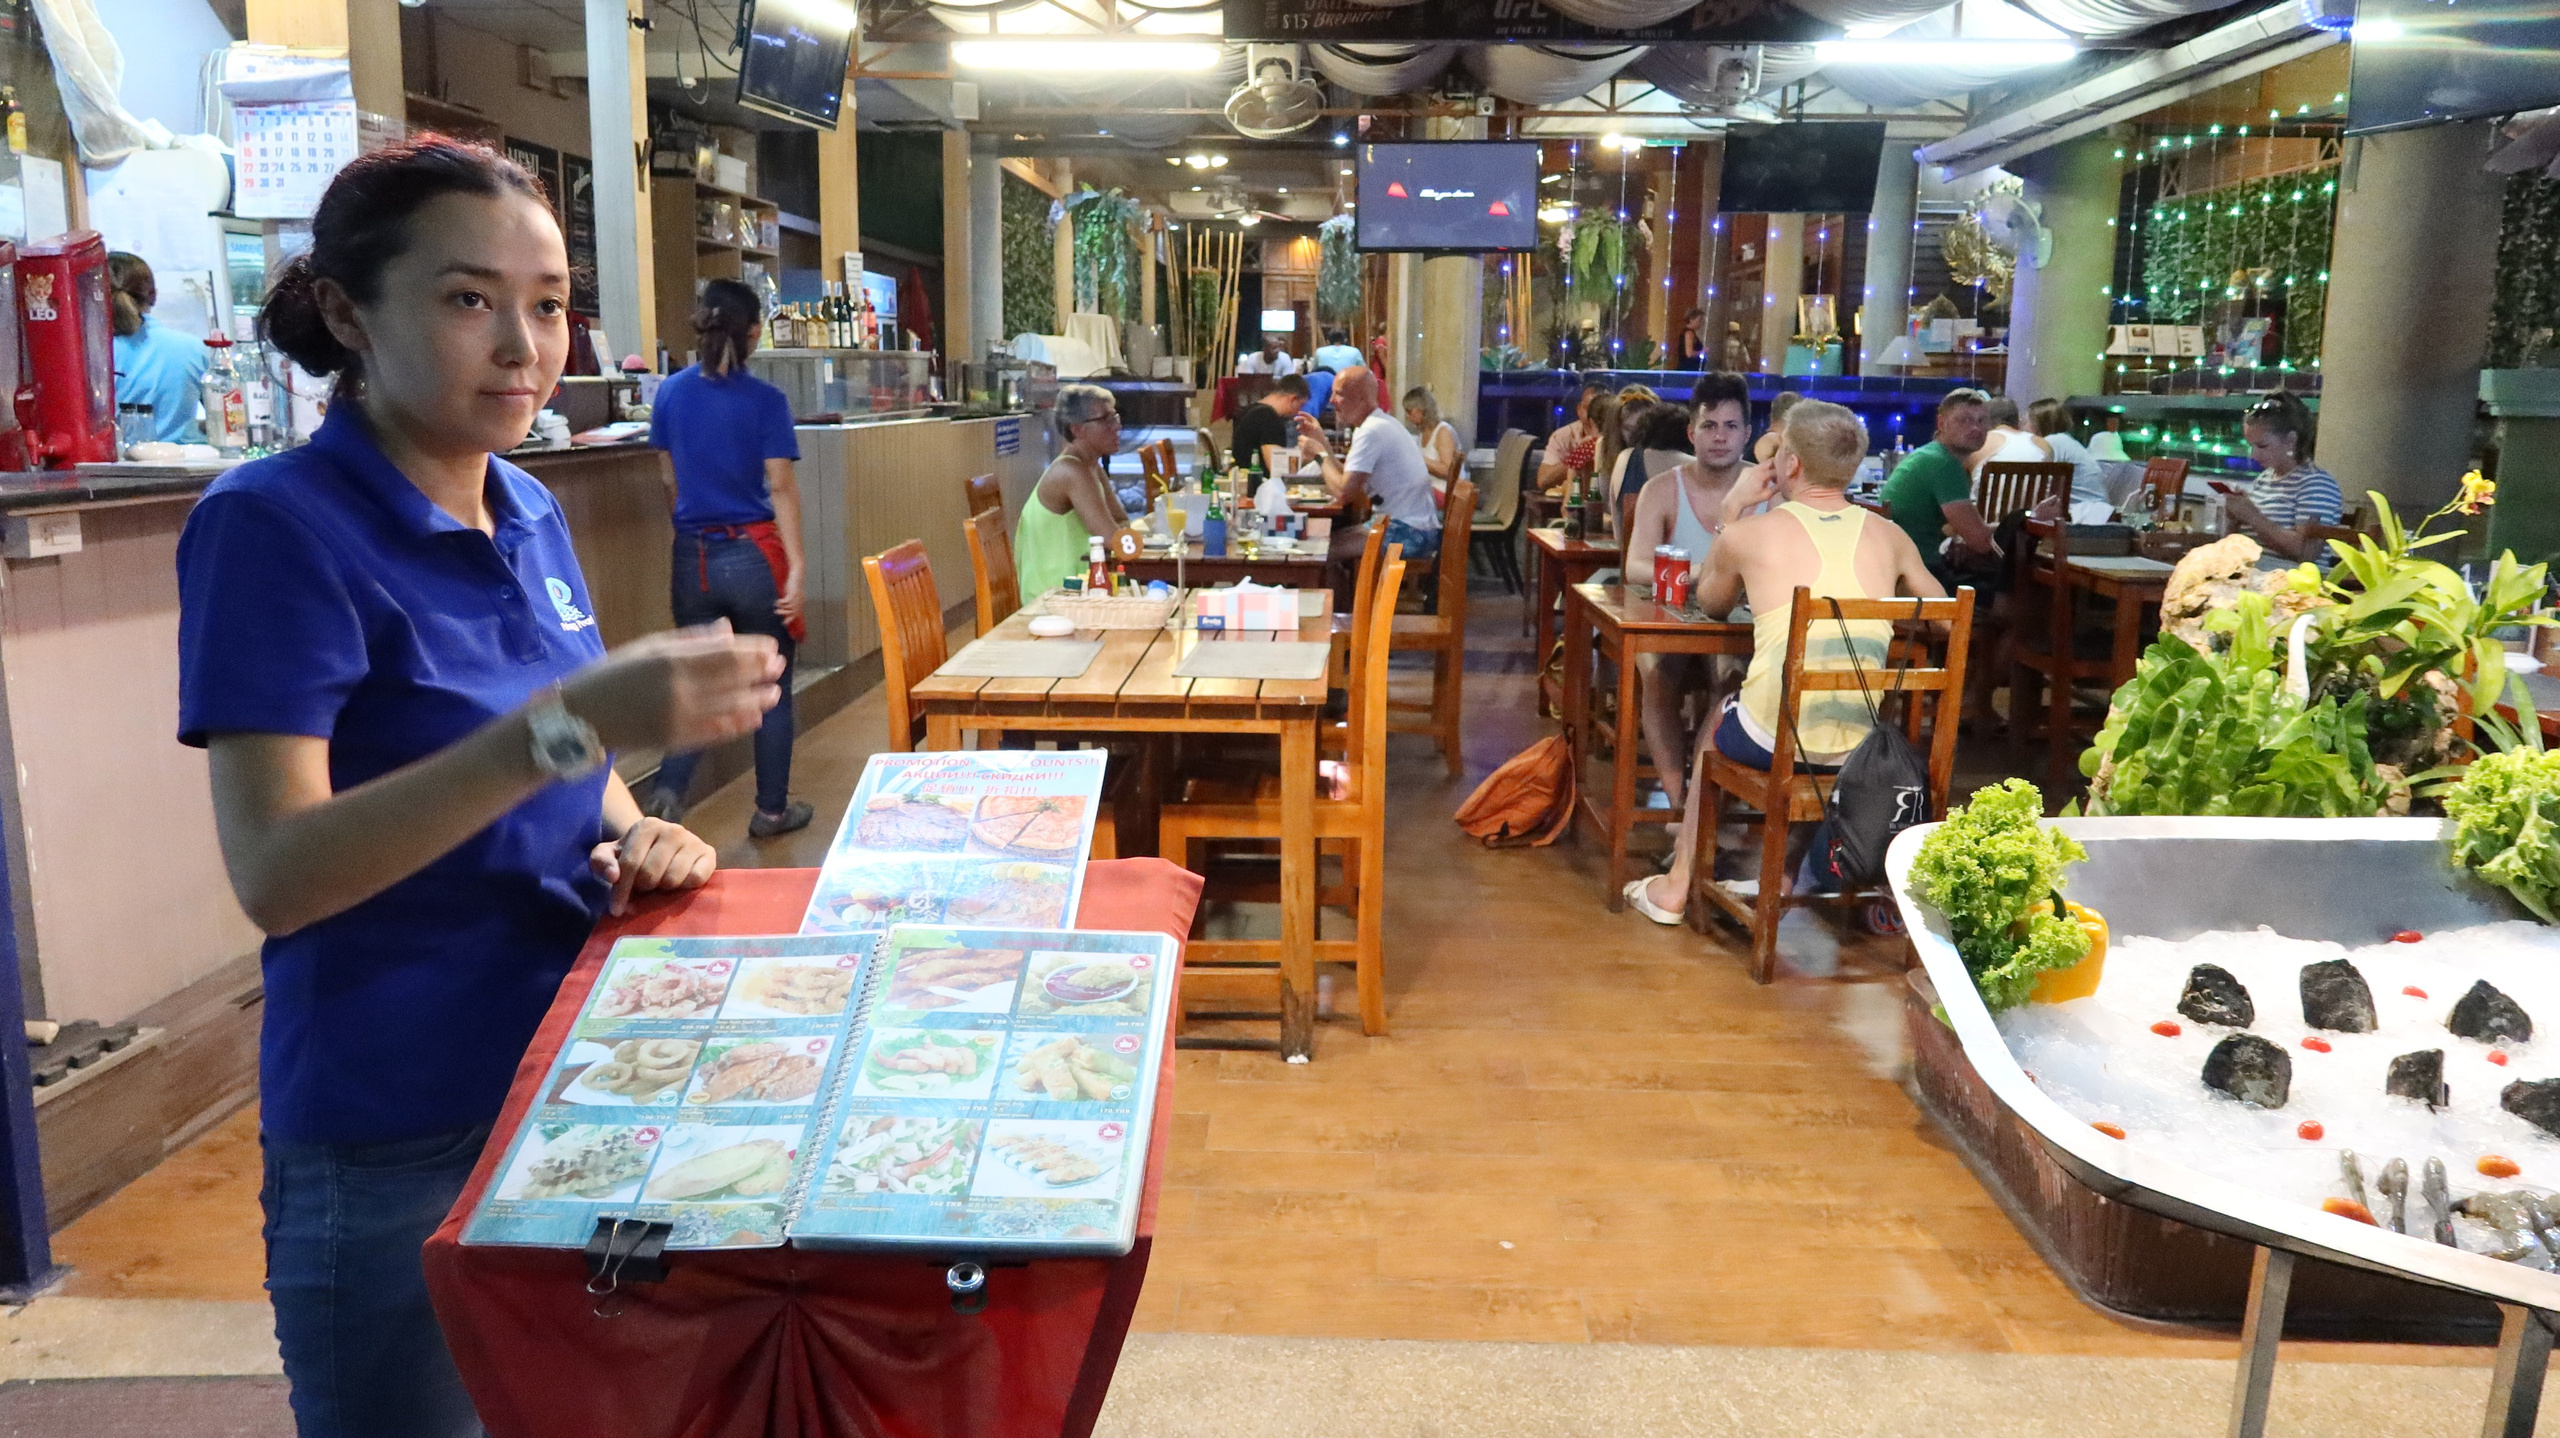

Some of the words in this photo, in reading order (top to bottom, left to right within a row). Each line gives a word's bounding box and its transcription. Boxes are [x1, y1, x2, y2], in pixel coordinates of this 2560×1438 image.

[1494, 0, 1549, 19] UFC
[244, 116, 248, 126] 1
[260, 116, 266, 126] 2
[276, 116, 282, 126] 3
[291, 116, 297, 126] 4
[308, 116, 314, 126] 5
[324, 116, 330, 126] 6
[244, 132, 250, 142] 8
[260, 132, 266, 142] 9
[274, 132, 283, 142] 10
[292, 132, 298, 142] 11
[306, 132, 316, 142] 12
[324, 132, 333, 142] 13
[244, 148, 252, 157] 15
[260, 148, 268, 157] 16
[274, 148, 283, 157] 17
[291, 148, 300, 157] 18
[308, 148, 317, 157] 19
[324, 148, 334, 157] 20
[243, 163, 254, 172] 22
[259, 163, 269, 172] 23
[274, 163, 285, 172] 24
[290, 163, 302, 172] 25
[308, 163, 318, 172] 26
[324, 163, 334, 172] 27
[244, 178, 254, 188] 29
[259, 178, 270, 188] 30
[276, 178, 285, 188] 31
[29, 308, 58, 320] LEO
[2148, 493, 2156, 508] 2
[1120, 534, 1137, 554] 8
[874, 758, 970, 768] PROMOTION
[1000, 758, 1100, 768] OUNTS!!!
[902, 771, 977, 781] АКЦИИ!!!
[981, 771, 1065, 782] СКИДКИ!!!
